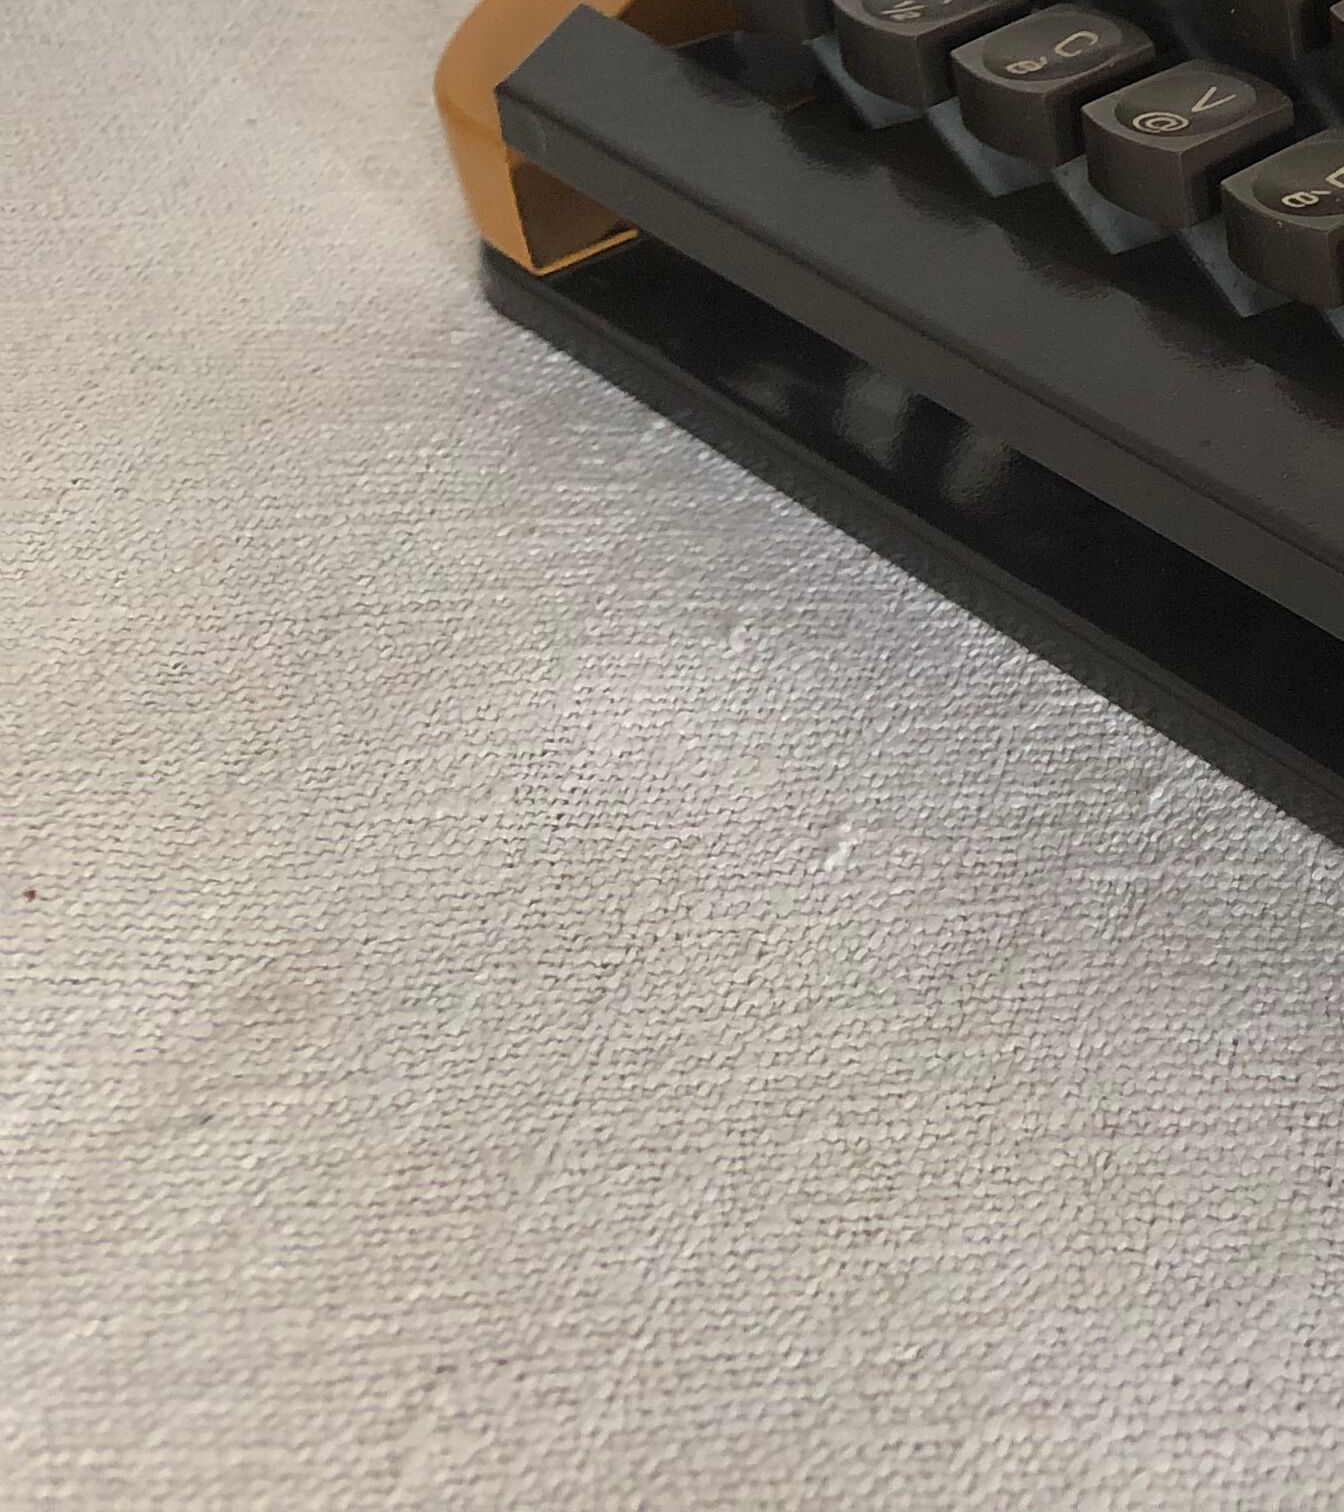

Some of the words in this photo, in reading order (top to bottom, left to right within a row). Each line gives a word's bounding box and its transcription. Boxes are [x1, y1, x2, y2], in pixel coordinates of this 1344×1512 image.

[1054, 29, 1100, 58] C
[1190, 86, 1238, 114] V
[1132, 111, 1190, 134] @
